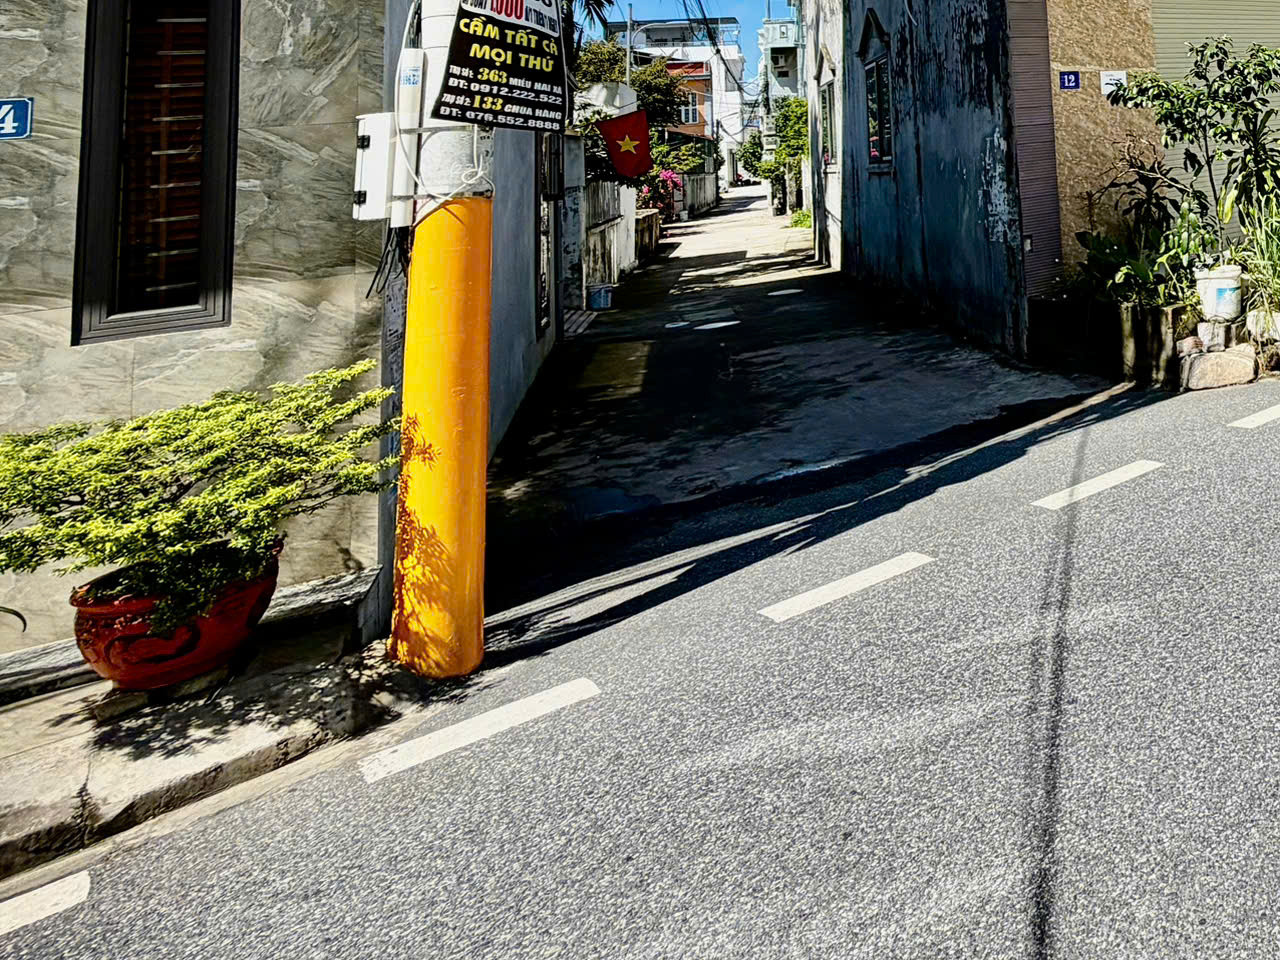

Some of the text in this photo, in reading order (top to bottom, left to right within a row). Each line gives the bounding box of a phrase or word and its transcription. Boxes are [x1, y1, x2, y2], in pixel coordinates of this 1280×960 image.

[459, 16, 558, 55] CẦM TẤT CẢ
[469, 43, 554, 72] MỌI THỨ
[477, 67, 507, 84] 363
[1064, 74, 1076, 86] 12
[470, 82, 562, 105] 0912.222.522
[472, 95, 503, 110] 133
